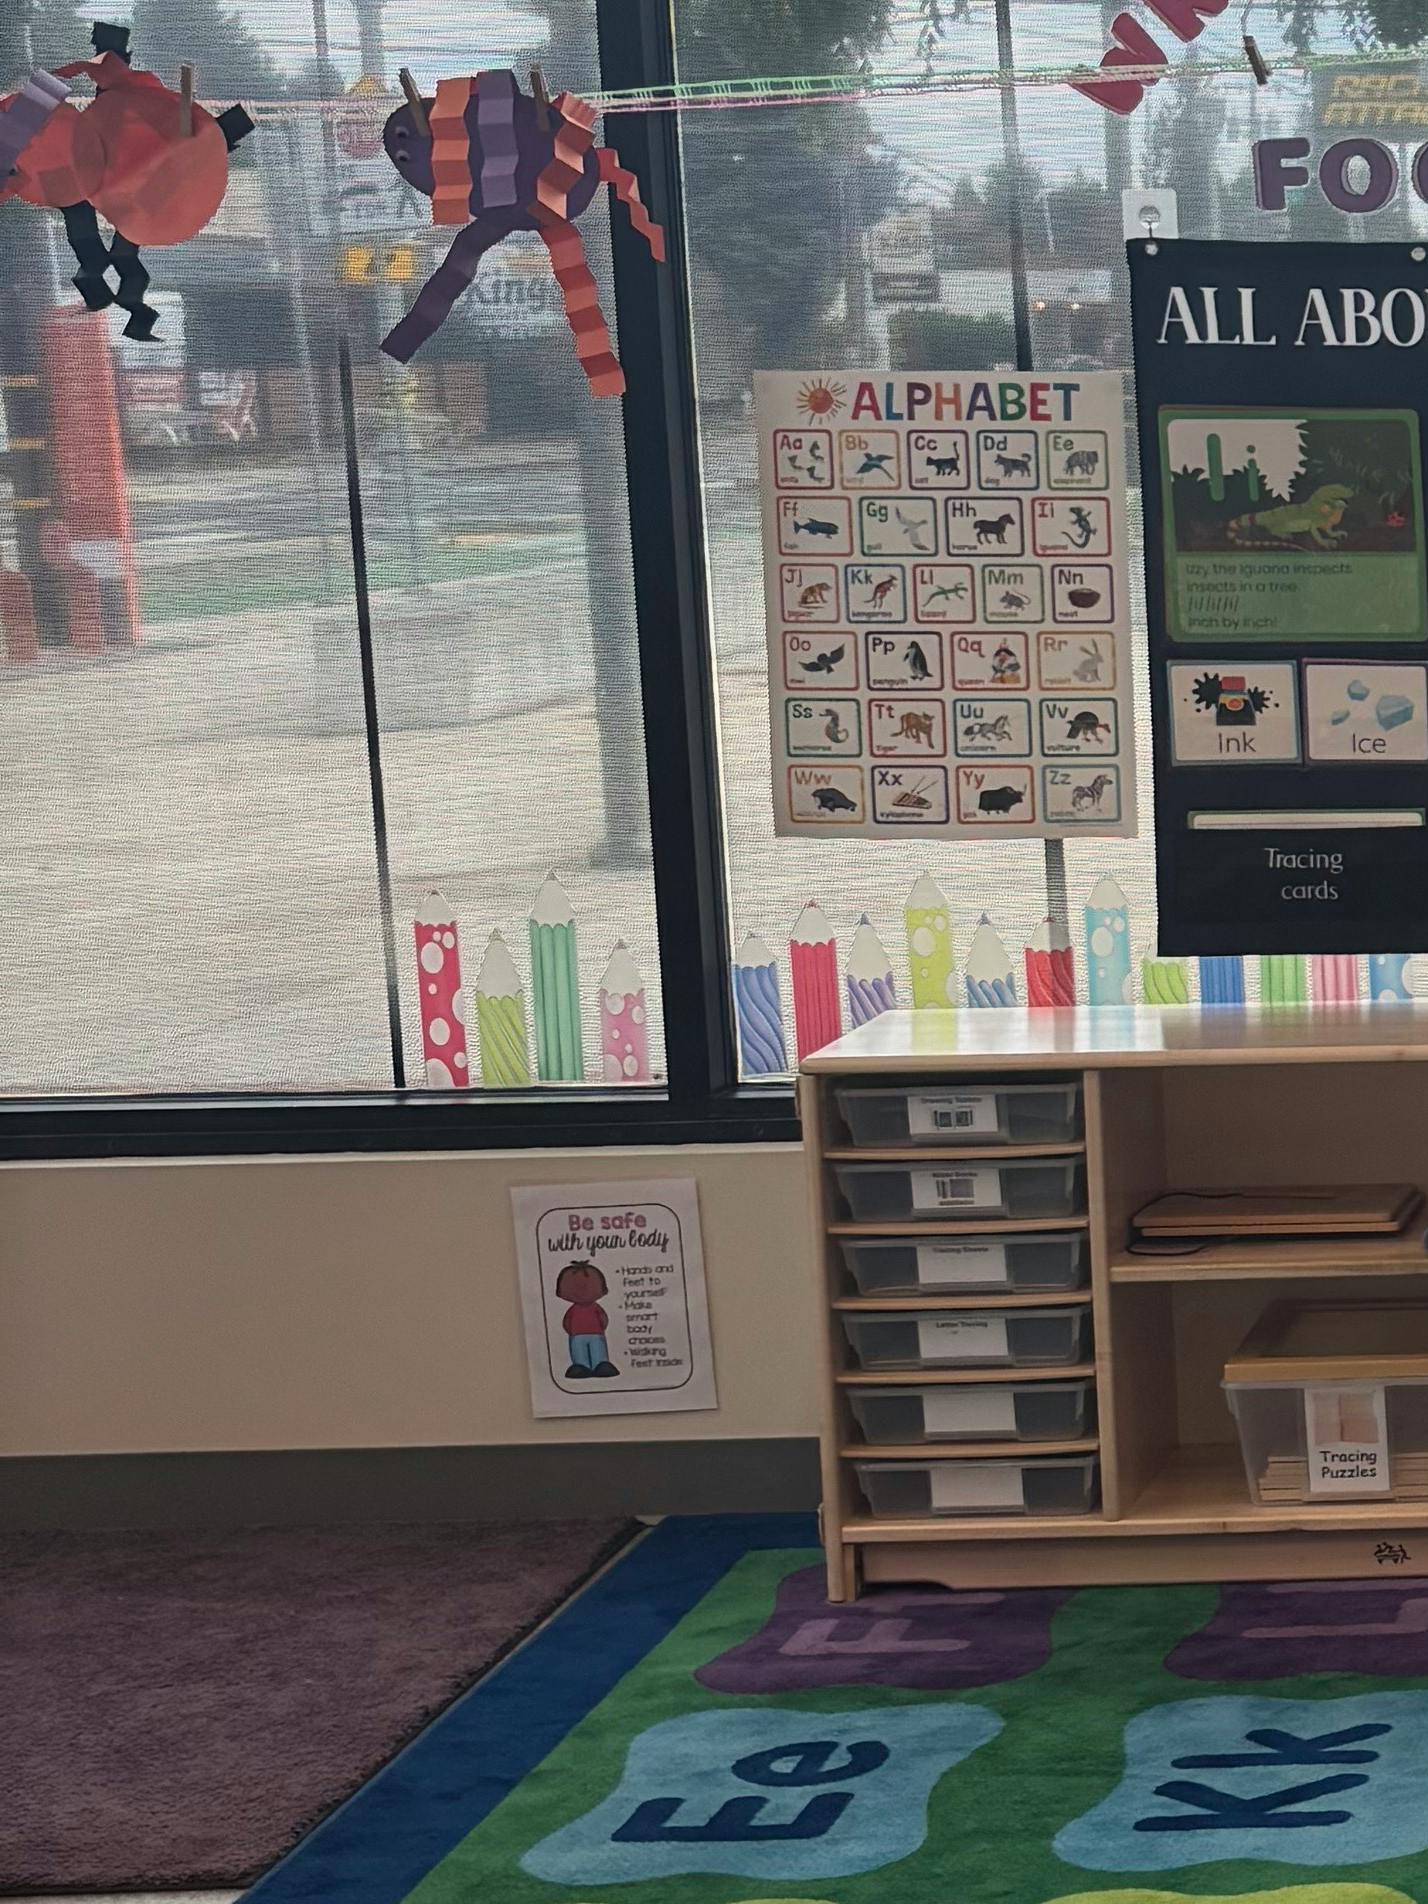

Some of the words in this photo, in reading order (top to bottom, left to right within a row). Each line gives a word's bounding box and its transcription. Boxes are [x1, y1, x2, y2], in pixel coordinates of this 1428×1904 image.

[1157, 286, 1277, 346] ALL
[851, 382, 1080, 421] ALPHABET
[779, 435, 803, 451] Aa
[845, 435, 868, 451] Bb
[914, 435, 938, 451] Cc
[984, 435, 1007, 451] Dd
[1052, 435, 1074, 451] Ee
[783, 502, 799, 518] Ff
[866, 502, 888, 523] Gg
[952, 501, 977, 518] Hh
[1037, 501, 1055, 518] Ii
[1212, 562, 1236, 575] the
[784, 570, 803, 588] Jj
[851, 569, 873, 585] Kk
[920, 569, 935, 586] Ll
[988, 569, 1024, 586] Mm
[1058, 569, 1085, 585] Nn
[1240, 581, 1253, 593] in
[1255, 583, 1266, 593] a
[789, 637, 812, 652] Oo
[872, 636, 896, 655] Pp
[958, 636, 985, 658] Qq
[1044, 636, 1068, 652] Rr
[792, 704, 813, 719] Ss
[875, 703, 895, 719] Tt
[960, 703, 984, 719] Uu
[1045, 703, 1070, 719] Vv
[1217, 732, 1257, 754] Ink
[1351, 733, 1388, 755] Ice
[794, 770, 832, 786] Ww
[877, 770, 903, 786] Xx
[962, 770, 985, 790] Yy
[1049, 770, 1072, 786] Zz
[1264, 846, 1344, 874] Tracing
[1281, 879, 1339, 902] cards
[568, 1214, 594, 1232] Be
[600, 1212, 647, 1230] safe
[548, 1232, 583, 1253] with
[586, 1232, 626, 1257] your
[628, 1228, 669, 1253] body
[621, 1264, 653, 1276] Hands
[655, 1263, 674, 1274] and
[649, 1276, 661, 1286] to
[624, 1300, 652, 1312] Make
[626, 1312, 658, 1323] smart
[627, 1324, 652, 1336] body
[628, 1336, 666, 1346] choices
[1319, 1449, 1378, 1465] Tracing
[1321, 1464, 1377, 1479] Puzzles
[1131, 1722, 1394, 1834] Kk
[610, 1738, 891, 1845] Ee
